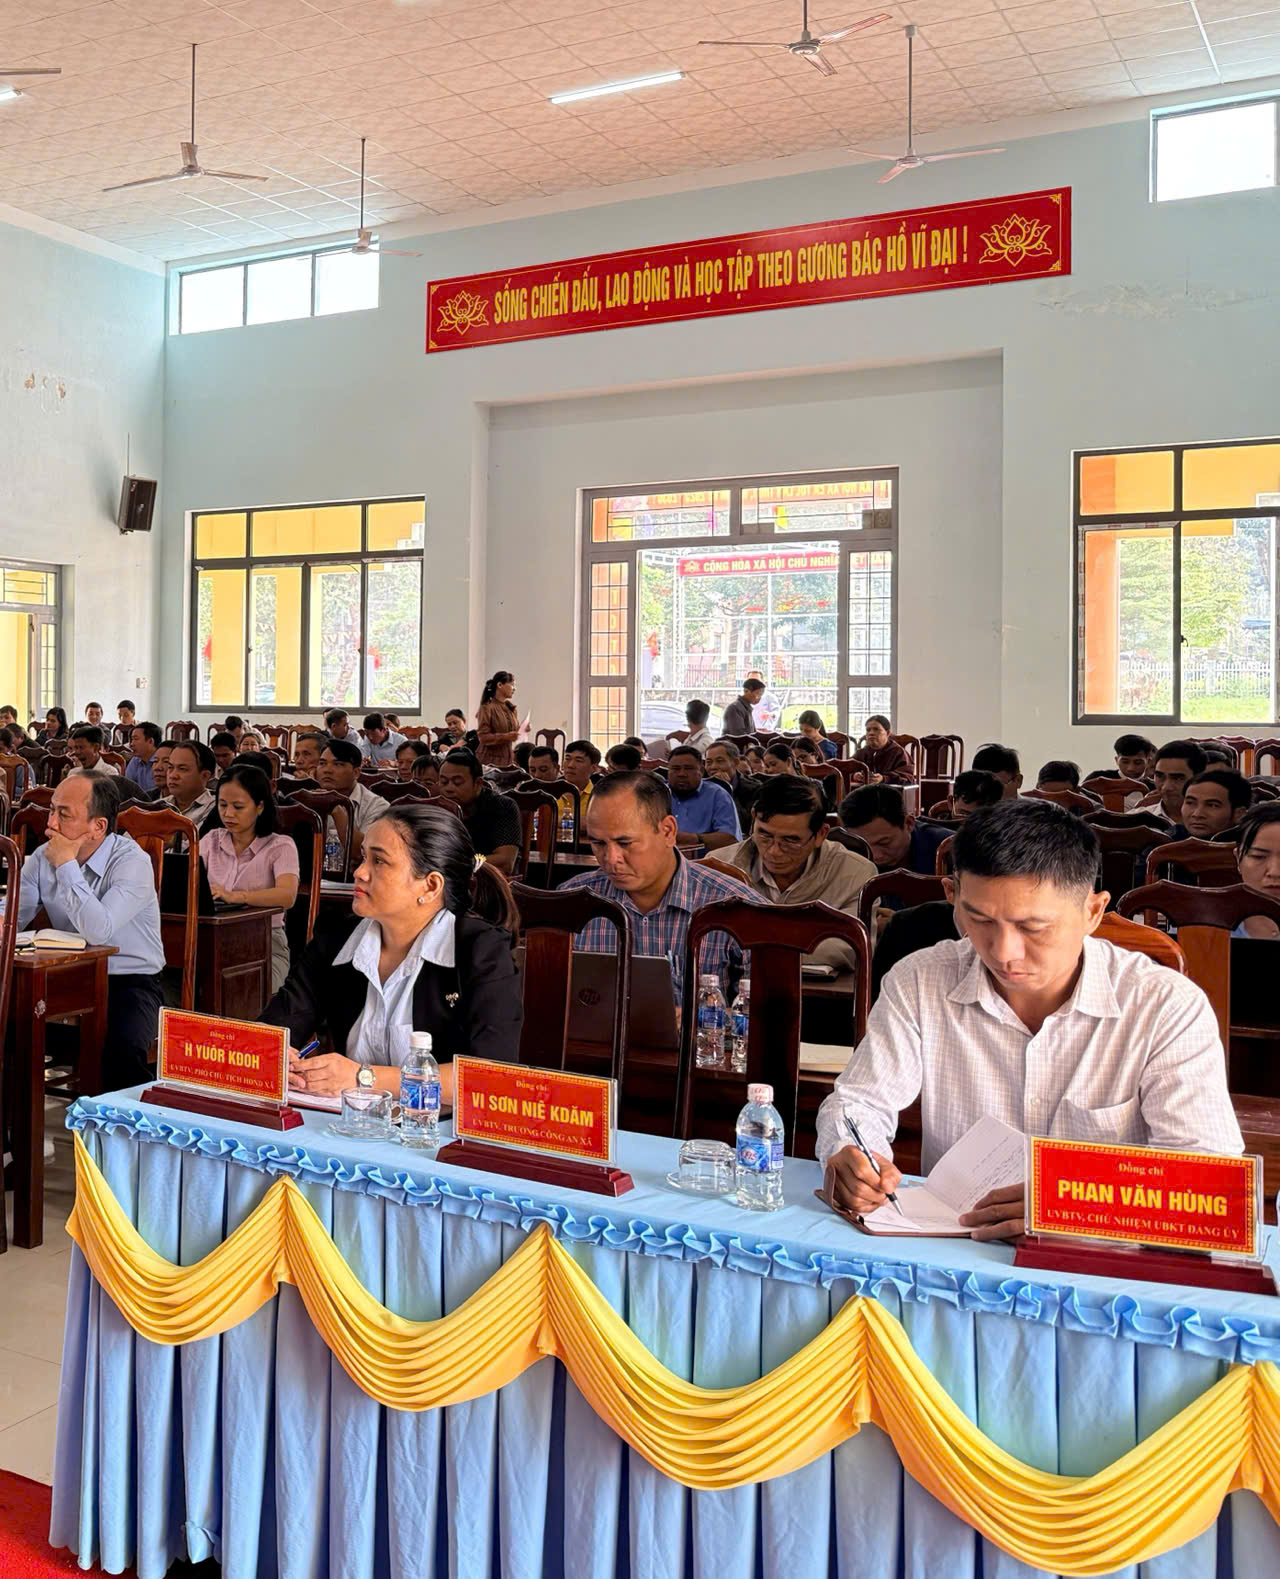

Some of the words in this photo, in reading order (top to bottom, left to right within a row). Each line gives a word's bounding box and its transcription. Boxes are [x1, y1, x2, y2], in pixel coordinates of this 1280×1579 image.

[493, 281, 528, 324] SỐNG
[531, 271, 568, 318] CHIẾN
[571, 269, 603, 315] ĐẤU,
[605, 273, 629, 309] LAO
[633, 262, 670, 311] ĐỘNG
[673, 261, 692, 299] VÀ
[695, 259, 723, 300] HỌC
[727, 252, 753, 295] TẬP
[758, 249, 793, 288] THEO
[798, 242, 847, 283] GƯƠNG
[851, 235, 881, 277] BÁC
[886, 222, 907, 273] HỒ
[910, 227, 927, 268] VĨ
[930, 229, 958, 275] ĐẠI
[184, 1041, 193, 1058] H
[472, 1091, 484, 1109] VI
[489, 1095, 517, 1115] SƠN
[522, 1100, 546, 1120] NIÊ
[550, 1105, 594, 1128] KDĂM
[1118, 1162, 1146, 1175] Đồng
[1148, 1165, 1164, 1176] chí
[1057, 1179, 1114, 1204] PHAN
[1120, 1184, 1162, 1209] VĂN
[1169, 1189, 1228, 1217] HÙNG
[1047, 1209, 1086, 1223] UVBTV,
[1114, 1215, 1152, 1231] NHIỆM
[1154, 1220, 1185, 1233] UBKT
